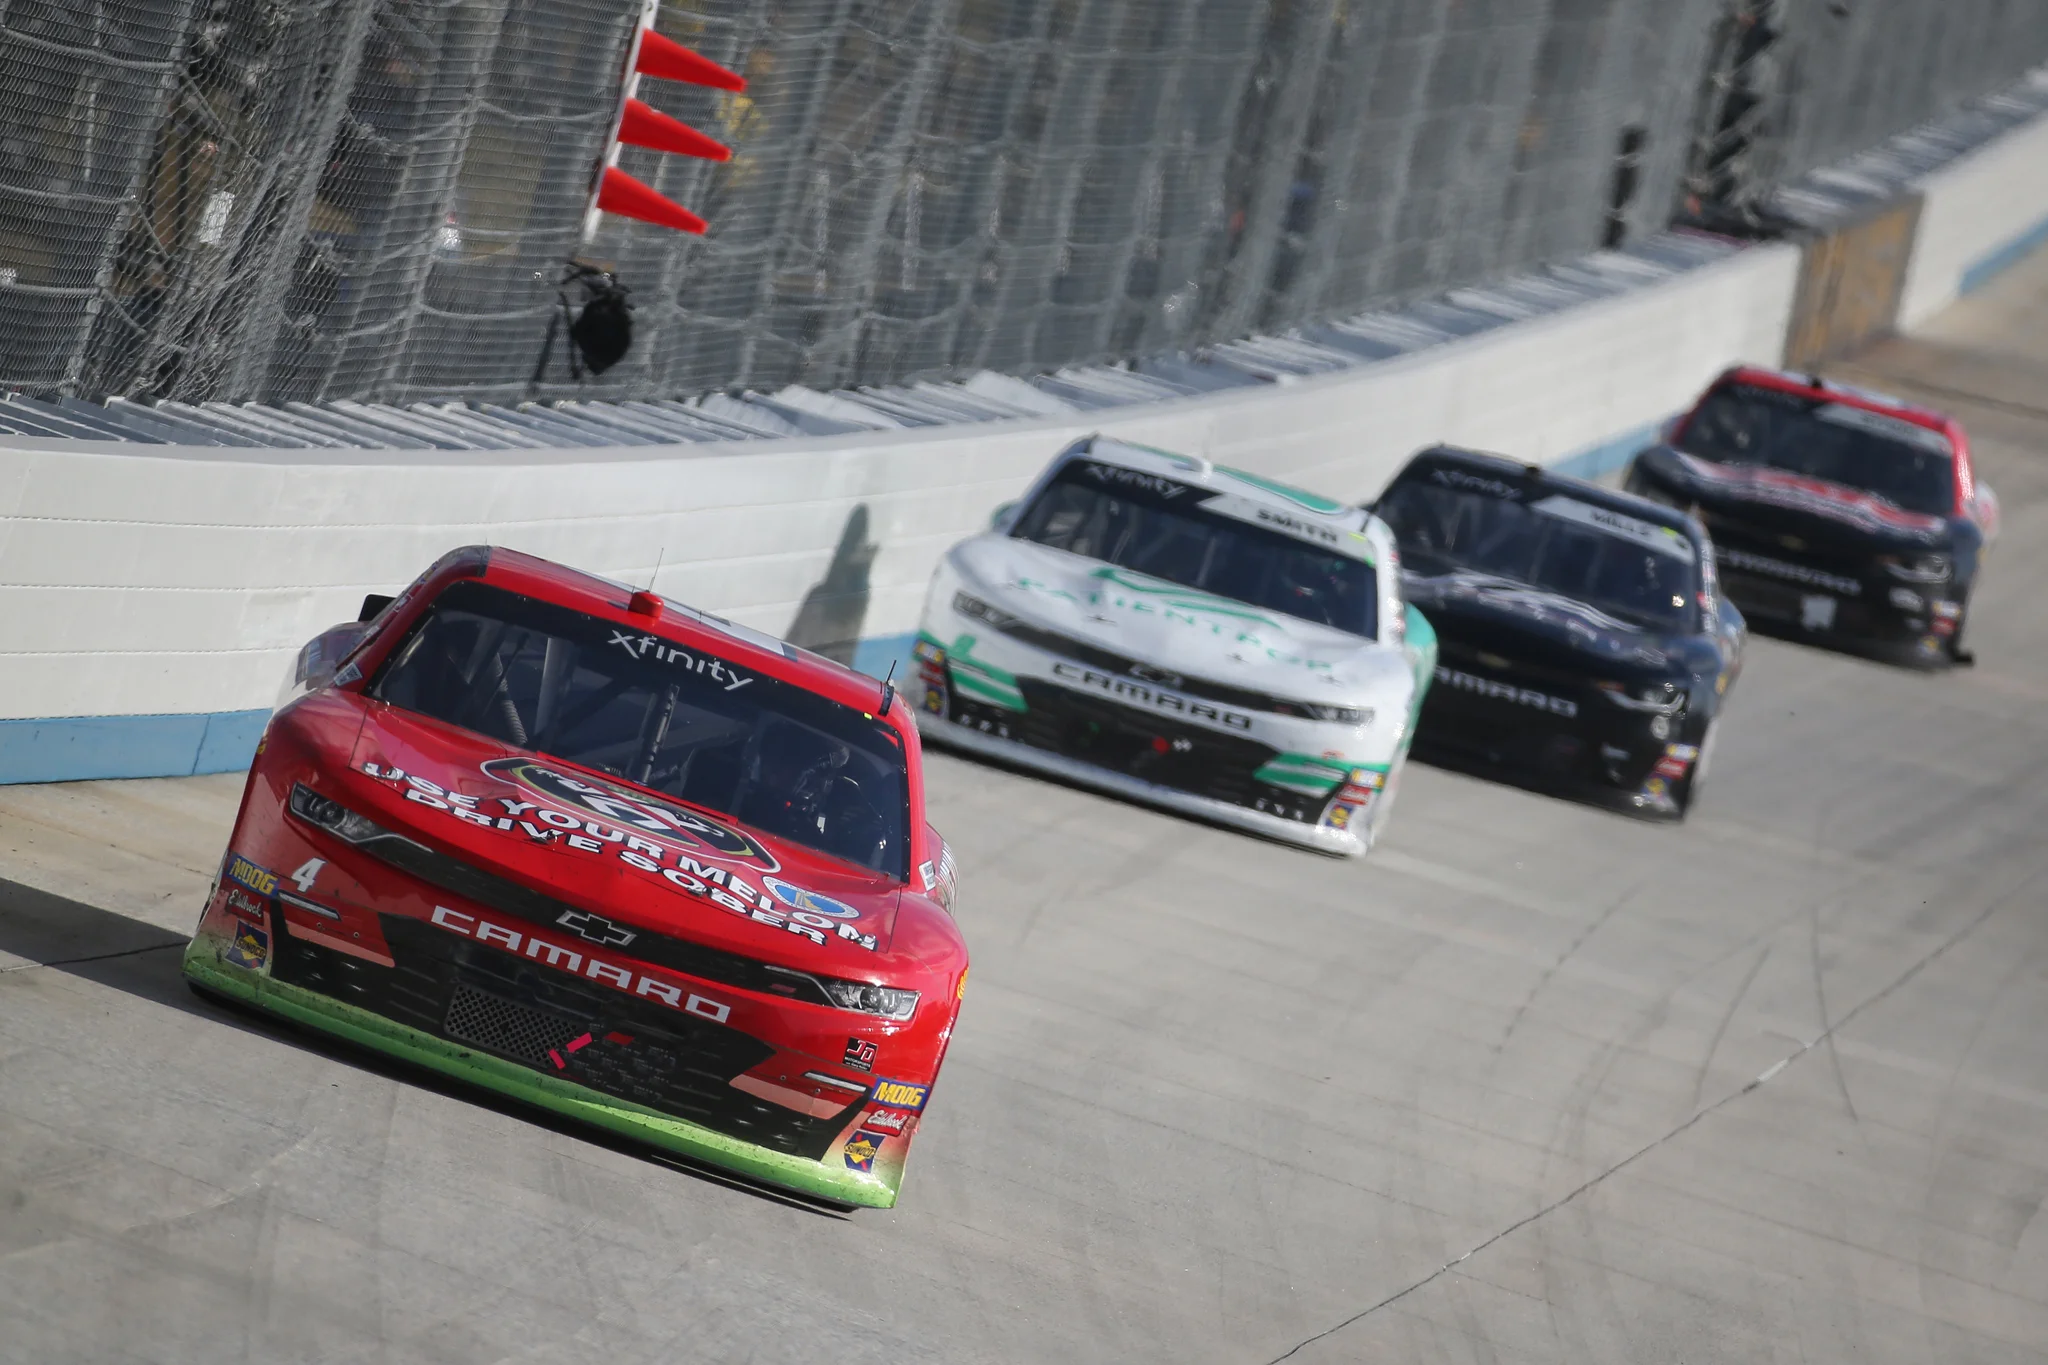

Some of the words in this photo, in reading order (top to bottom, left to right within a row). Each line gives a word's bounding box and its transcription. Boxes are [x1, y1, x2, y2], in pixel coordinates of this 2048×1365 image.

[1257, 508, 1338, 543] SMITH
[607, 629, 753, 691] xfinity
[1053, 662, 1251, 729] CAMARO
[1434, 665, 1578, 718] AMARO
[229, 858, 279, 896] MOOG
[291, 856, 327, 893] 4
[361, 761, 481, 811] USE
[498, 799, 664, 859] YOUR
[678, 855, 879, 951] MELON
[404, 788, 603, 854] DRIVE
[618, 850, 828, 946] SOBER
[235, 937, 267, 959] SUNOCO
[431, 905, 731, 1023] CAMARO
[873, 1081, 926, 1107] MOOG
[844, 1143, 876, 1159] SUNOCO
